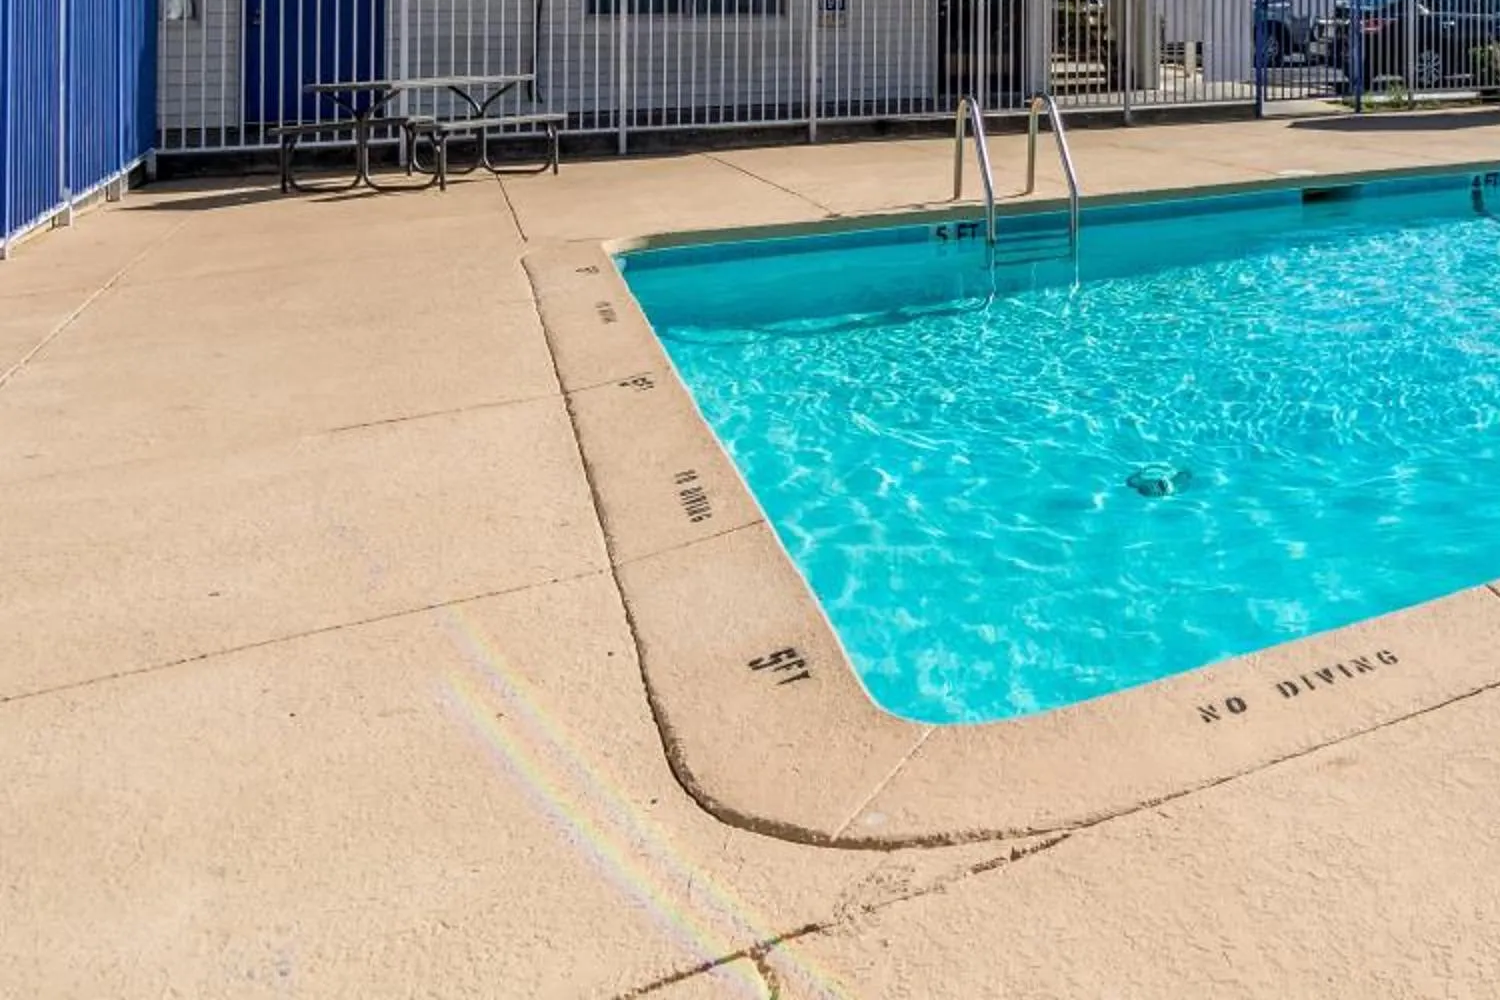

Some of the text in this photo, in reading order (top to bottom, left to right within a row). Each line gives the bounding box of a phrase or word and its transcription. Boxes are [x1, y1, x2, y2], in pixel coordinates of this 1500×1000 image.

[957, 223, 978, 240] FT
[1197, 649, 1400, 724] NO DIVING
